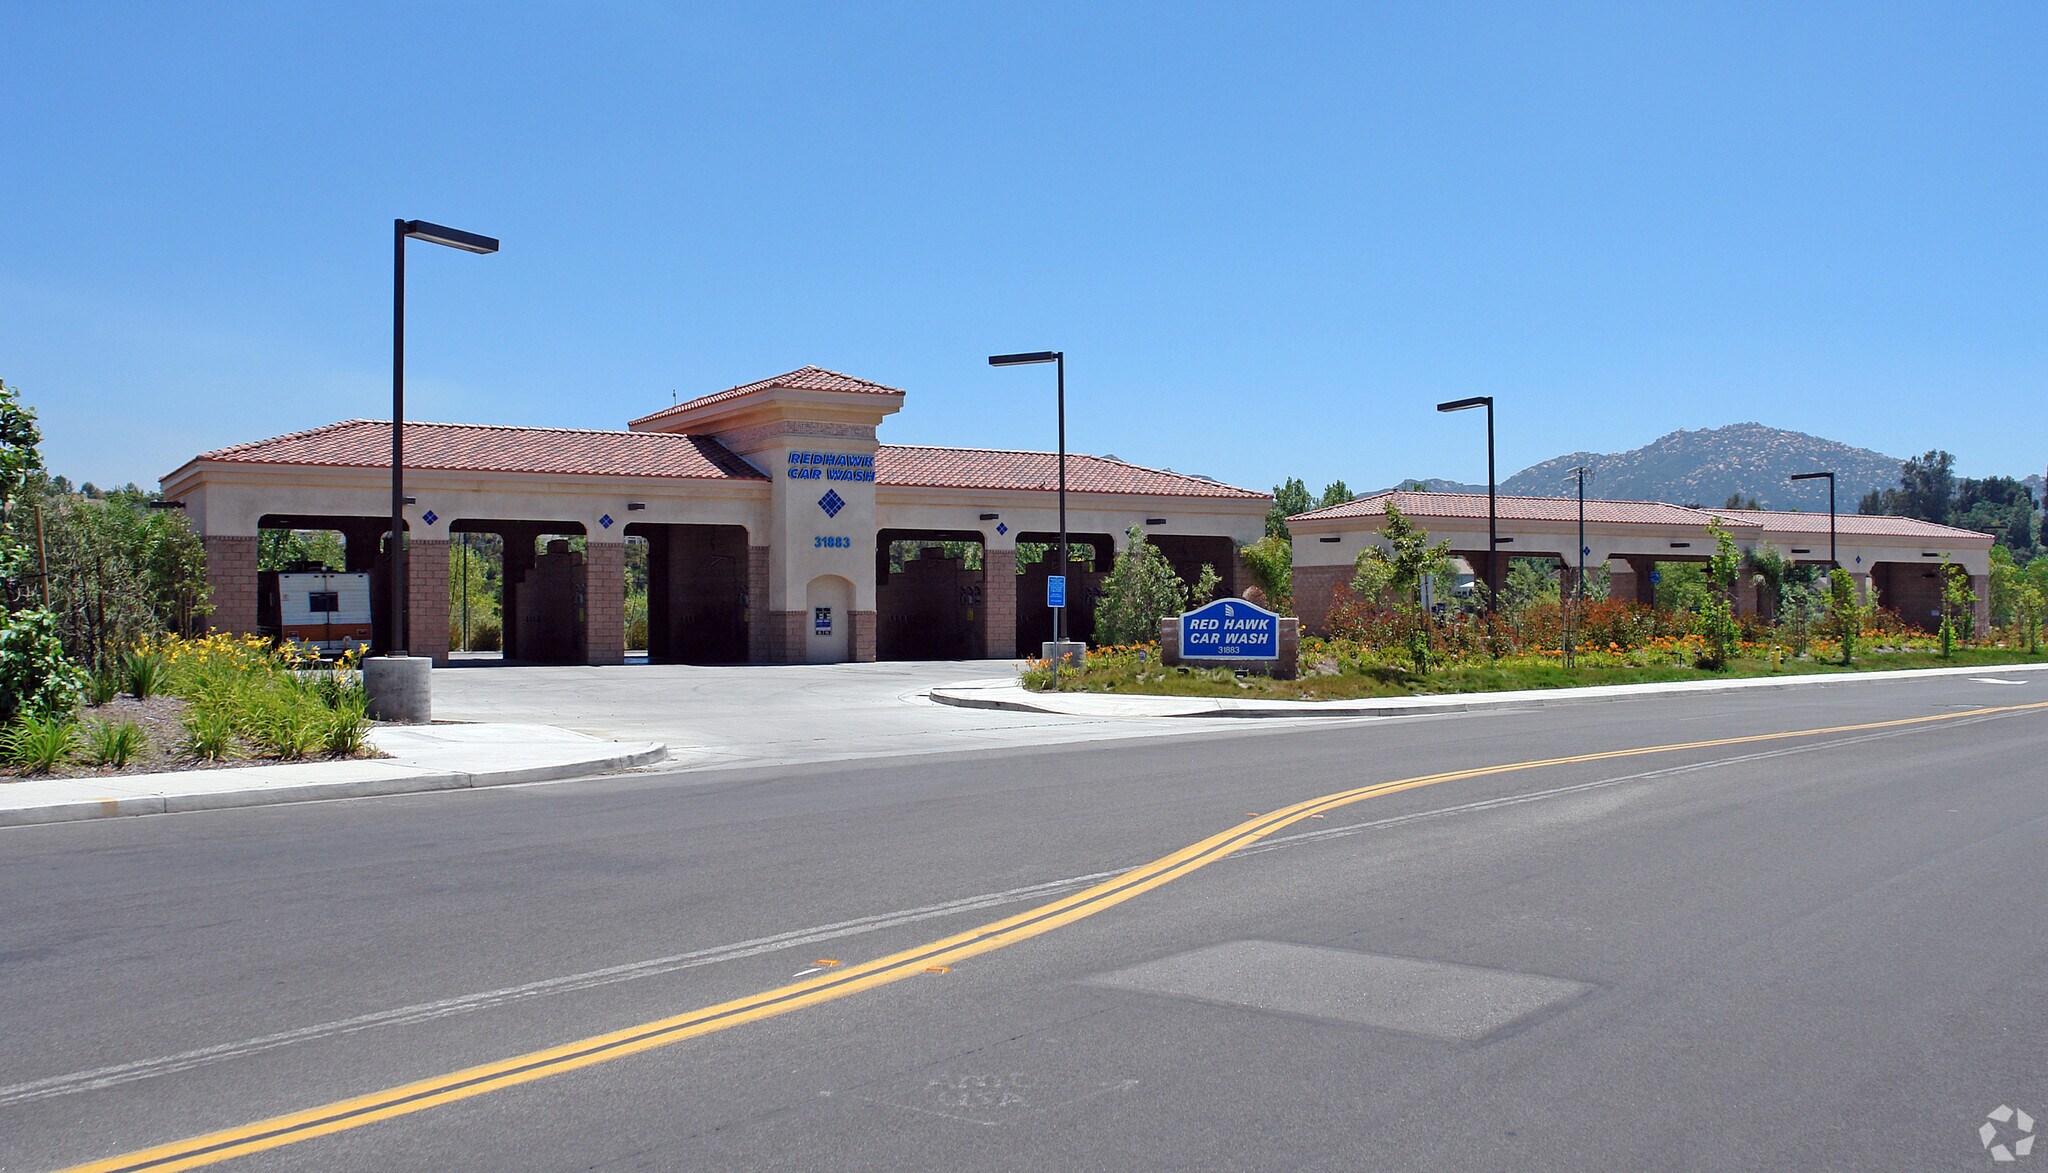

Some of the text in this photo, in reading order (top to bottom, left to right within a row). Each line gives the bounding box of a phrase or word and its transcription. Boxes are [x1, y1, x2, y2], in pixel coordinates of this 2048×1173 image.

[788, 452, 875, 467] REDHAWK
[788, 467, 875, 481] CAR WASH
[814, 536, 850, 548] 31883
[1189, 619, 1269, 630] RED HAWK
[1190, 633, 1269, 644] CAR WASH
[1218, 646, 1240, 654] 31883
